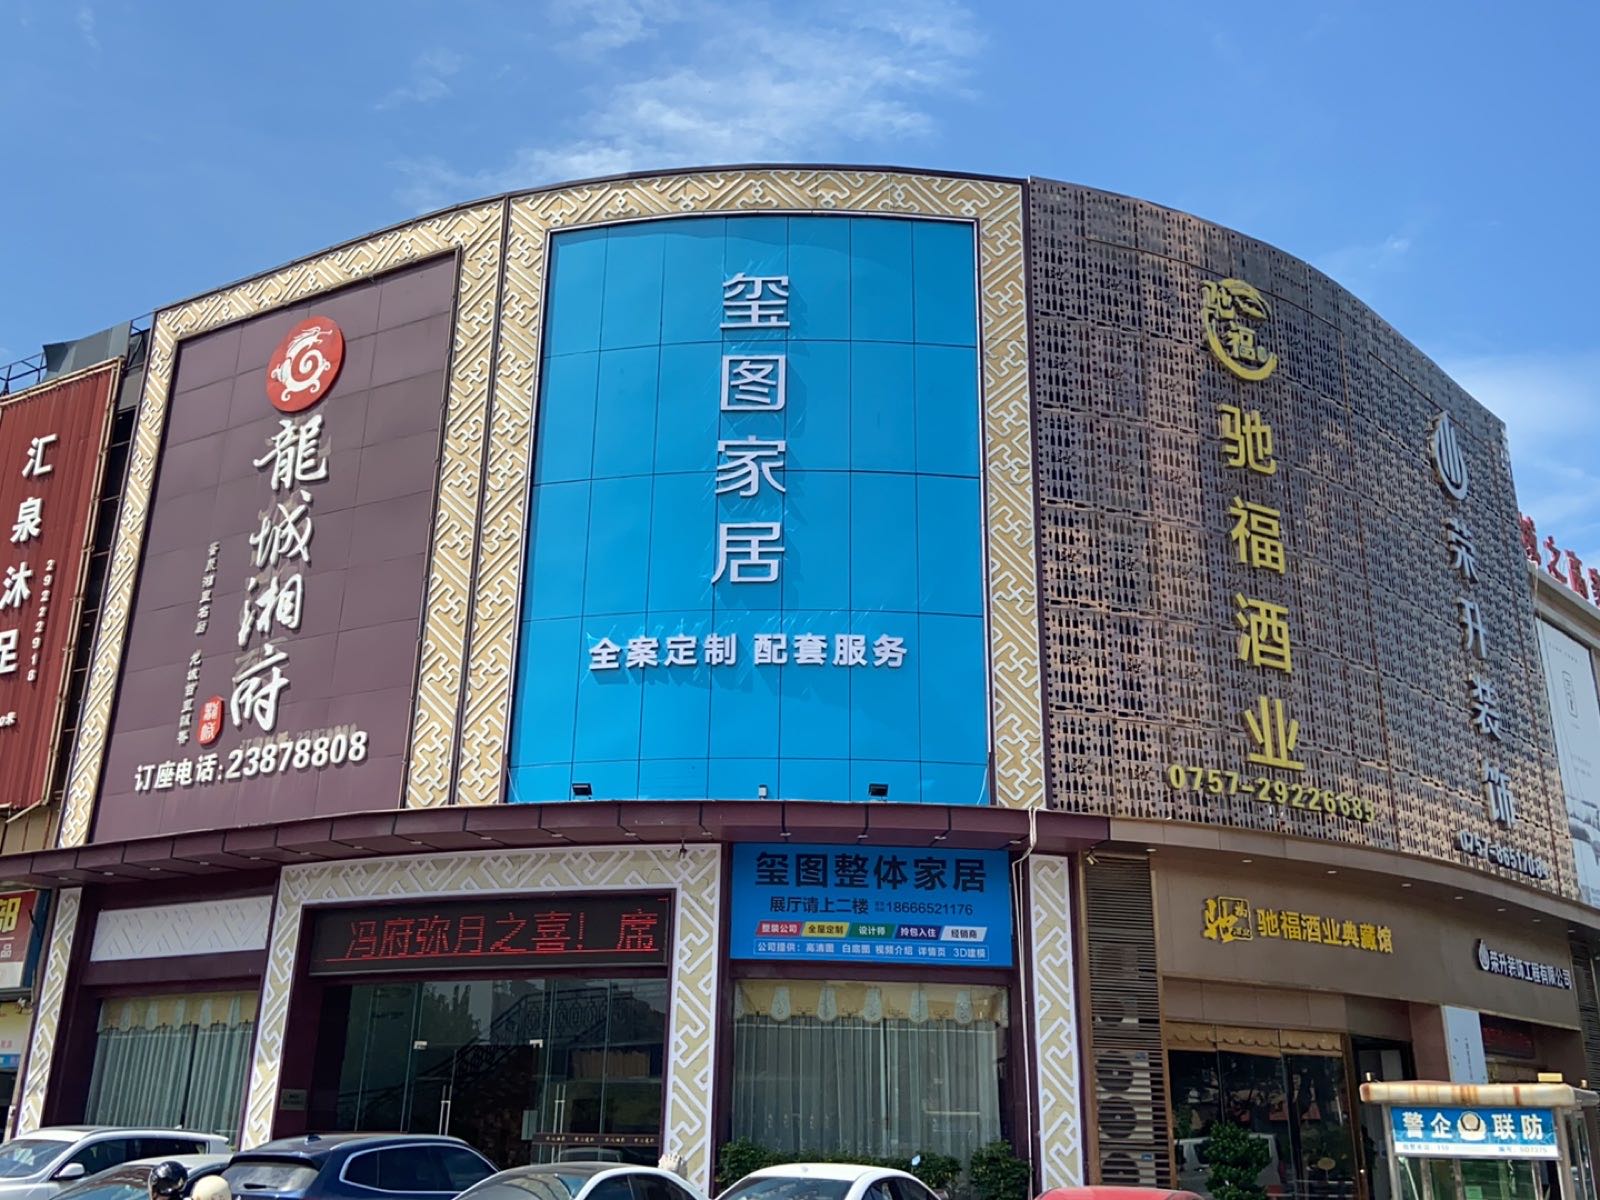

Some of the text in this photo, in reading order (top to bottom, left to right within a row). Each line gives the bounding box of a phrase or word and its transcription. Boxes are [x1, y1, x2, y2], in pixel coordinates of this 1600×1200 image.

[711, 272, 791, 586] 玺图家居
[1216, 403, 1305, 772] 驰福酒业
[588, 633, 908, 671] 全案定制 配套服务
[1444, 516, 1516, 830] 荣升装饰
[755, 852, 987, 893] 玺图整体家居
[769, 895, 870, 915] 展厅请上二楼
[886, 900, 974, 917] 18666521176
[808, 924, 845, 935] 全屋定制
[858, 926, 887, 937] 设计师
[900, 926, 937, 938] 拎包入住
[950, 928, 978, 940] 经销商
[1256, 907, 1394, 953] 驰福酒业典藏馆
[875, 945, 914, 957] 视频介绍
[953, 947, 987, 959] 3D建模
[1490, 949, 1572, 991] 荣升装饰工程有限公司
[1402, 1111, 1544, 1140] 警企 联防
